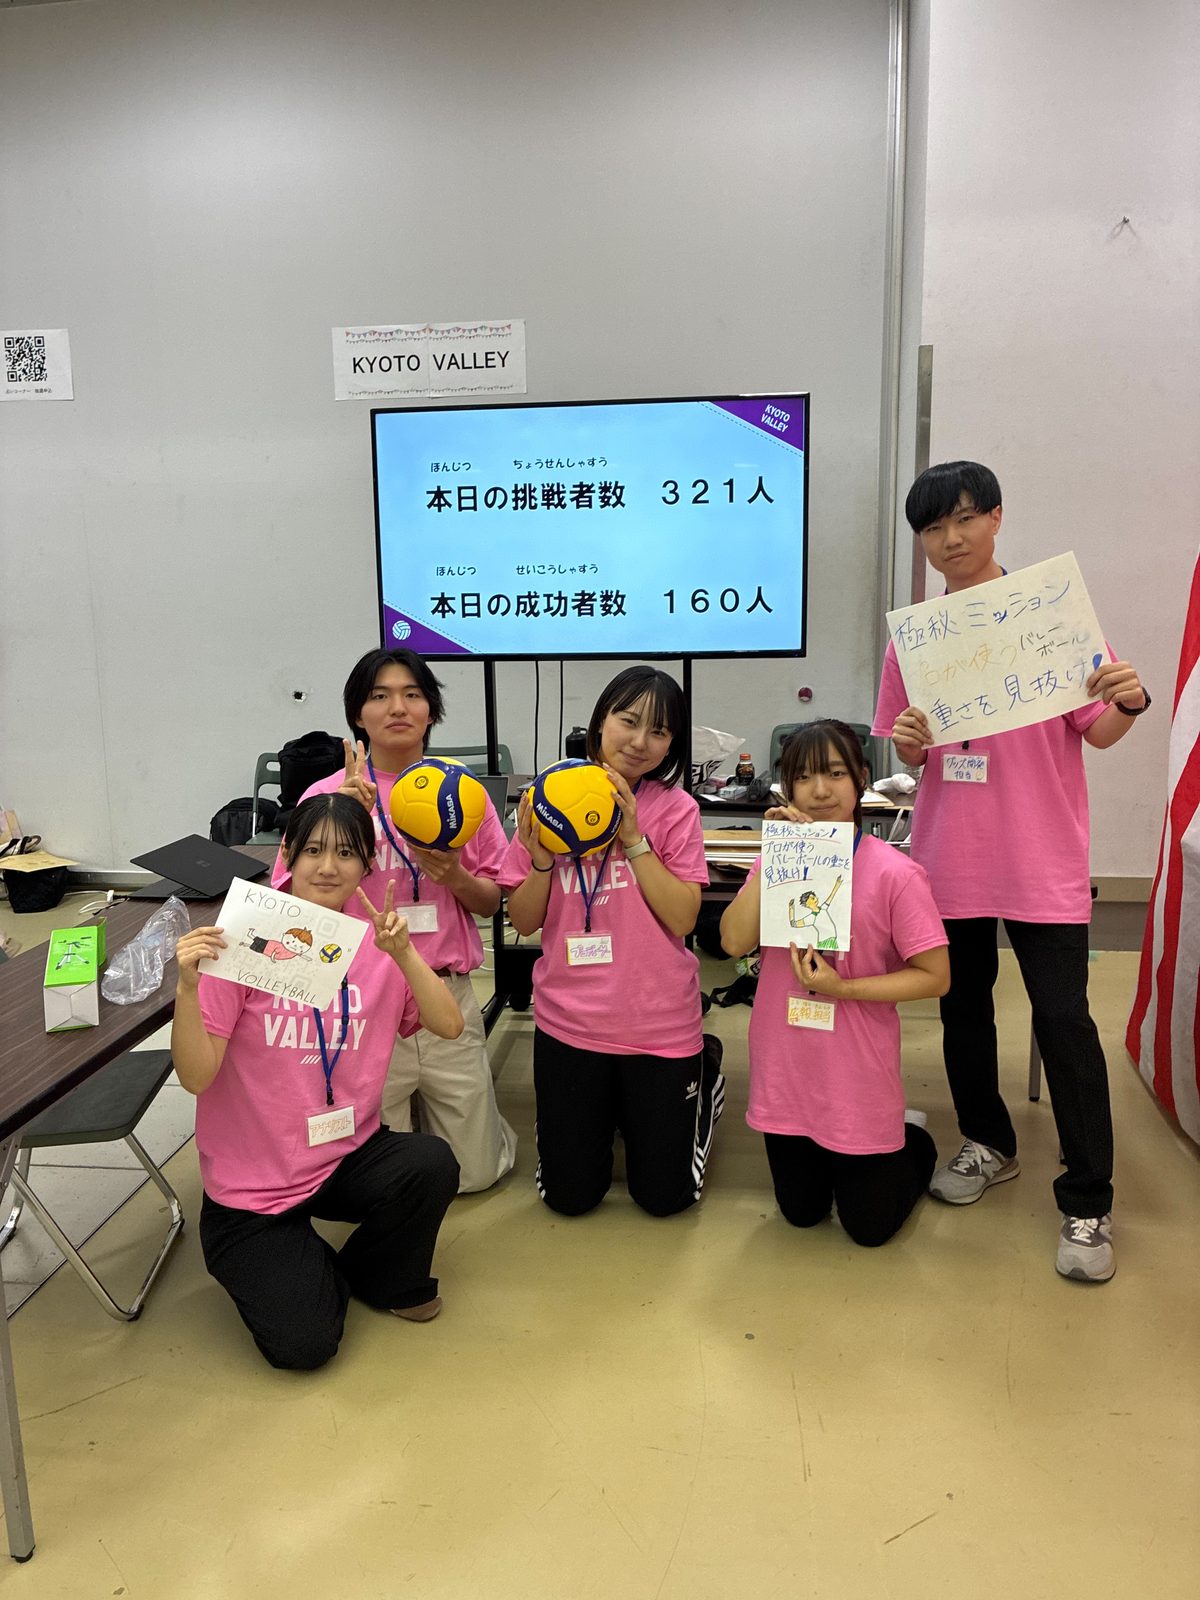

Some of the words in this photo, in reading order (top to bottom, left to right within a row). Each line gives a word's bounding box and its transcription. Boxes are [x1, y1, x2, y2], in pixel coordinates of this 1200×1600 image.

[352, 354, 421, 374] KYOTO
[433, 350, 510, 371] VALLEY
[761, 413, 789, 433] VALLEY
[764, 403, 791, 422] KYOTO
[430, 461, 472, 473] ほんじつ
[513, 456, 608, 470] ちょうせんしゃすう
[426, 480, 626, 513] 本日の挑戦者数
[661, 475, 775, 505] 321人
[436, 565, 477, 577] ほんじつ
[515, 563, 599, 575] せいこうしゃすう
[430, 589, 627, 619] 本日の成功者数
[663, 585, 774, 614] 160人
[763, 839, 815, 854] プロが使う
[244, 888, 302, 918] KYOTO
[237, 969, 318, 1004] VOLLEYBALL
